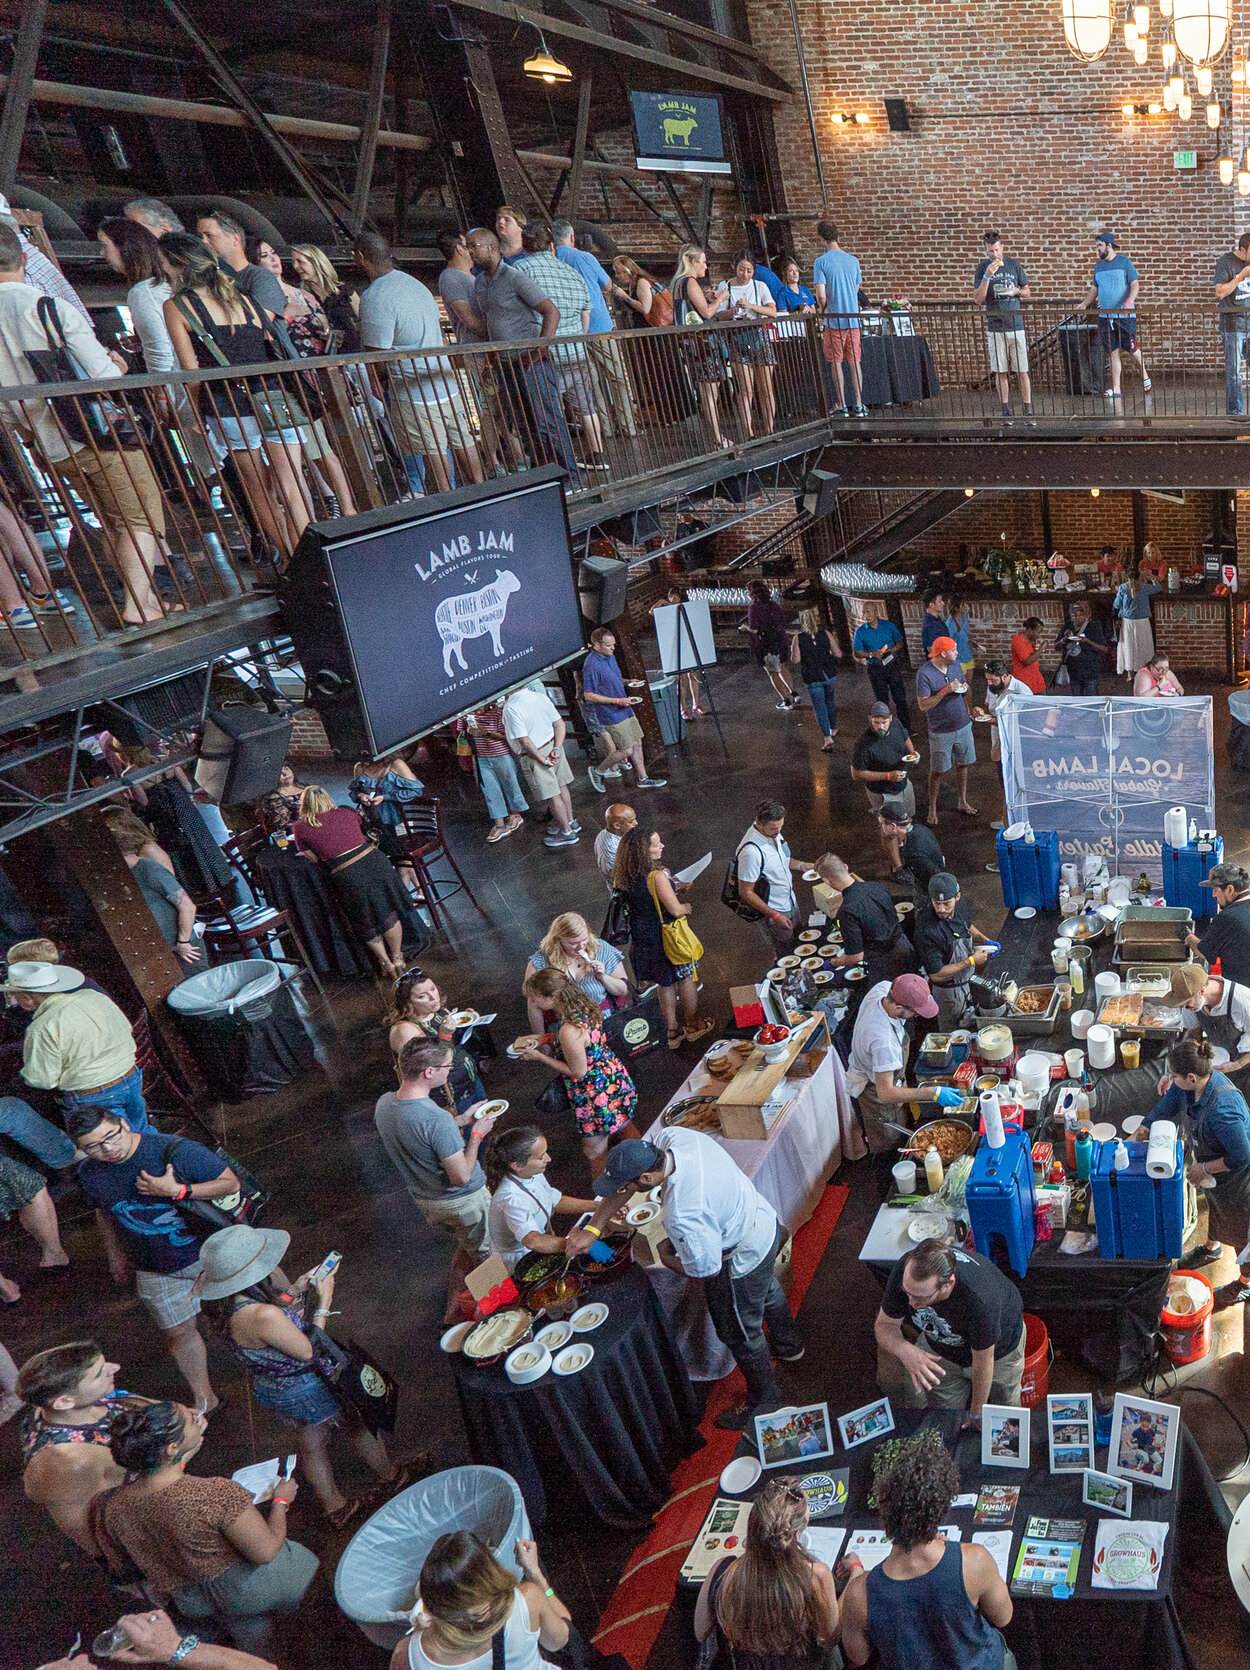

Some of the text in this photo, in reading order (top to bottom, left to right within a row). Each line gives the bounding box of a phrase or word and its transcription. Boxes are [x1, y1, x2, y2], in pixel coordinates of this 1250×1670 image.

[657, 101, 679, 111] LAMB
[680, 102, 697, 115] JAM
[1178, 152, 1193, 166] EXIT
[414, 530, 514, 581] LAMB JAM
[438, 563, 460, 579] GLOBAL
[460, 555, 485, 567] FLAVORS
[439, 646, 534, 696] CHEF COMPETITION TASTING
[981, 1501, 1011, 1511] TAMBIÉN
[1110, 1550, 1146, 1558] GROWHAUS
